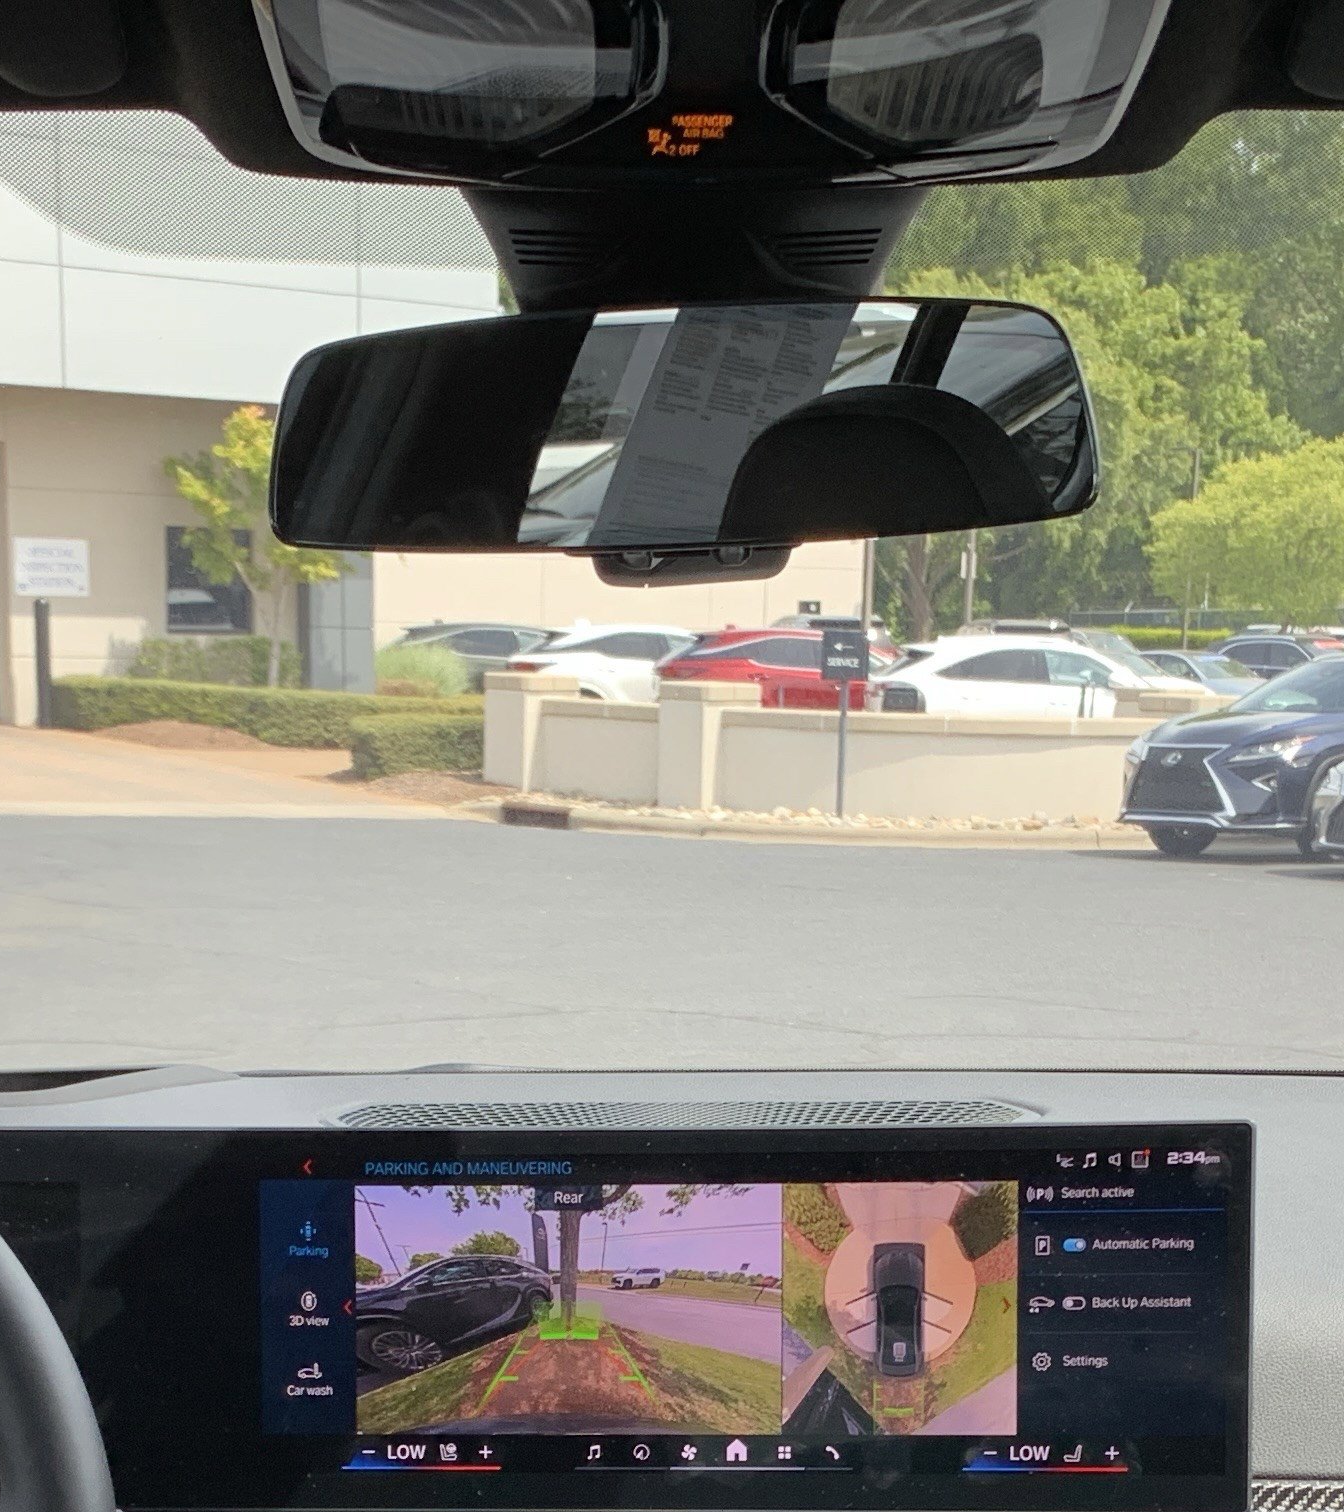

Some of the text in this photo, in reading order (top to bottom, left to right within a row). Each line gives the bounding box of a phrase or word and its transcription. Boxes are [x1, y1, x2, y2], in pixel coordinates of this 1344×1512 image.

[672, 114, 733, 127] PASSENGER
[683, 128, 702, 139] AIR
[679, 143, 700, 156] OFF
[827, 656, 860, 669] SERVICE
[364, 1160, 573, 1176] PARKING AND MANEUVERING
[554, 1190, 583, 1204] Rear
[1060, 1186, 1100, 1199] Search
[1101, 1186, 1135, 1198] active
[1092, 1237, 1195, 1251] Automatic Parking
[288, 1245, 329, 1259] Parking
[1091, 1296, 1192, 1310] Back Up Assistant
[289, 1315, 330, 1327] 3D view
[1062, 1355, 1109, 1369] Settings
[286, 1384, 334, 1396] Car wash
[387, 1444, 426, 1460] LOW
[1009, 1445, 1051, 1461] LOW
